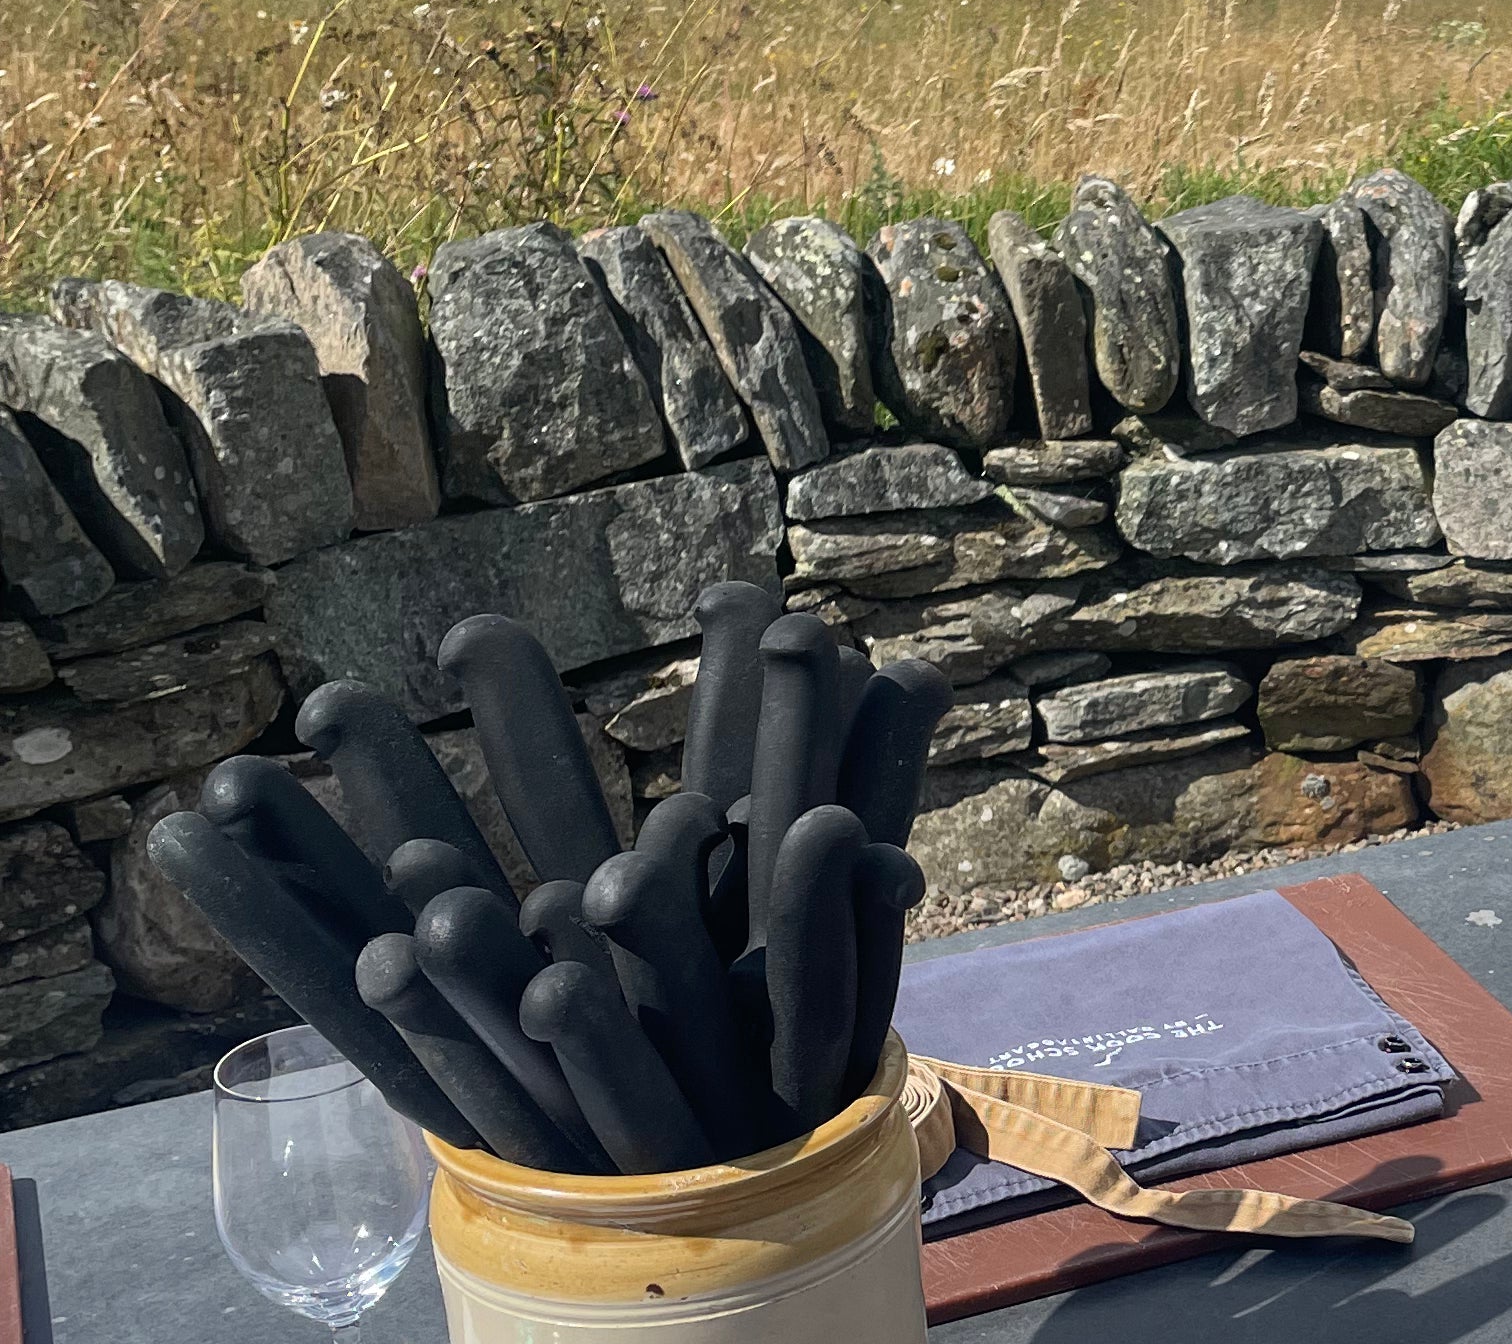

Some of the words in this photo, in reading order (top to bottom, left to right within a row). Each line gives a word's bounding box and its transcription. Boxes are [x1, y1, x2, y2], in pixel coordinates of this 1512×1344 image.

[1171, 1020, 1224, 1039] THE
[1086, 1032, 1162, 1052] COOK
[989, 1046, 1080, 1070] SCHOO
